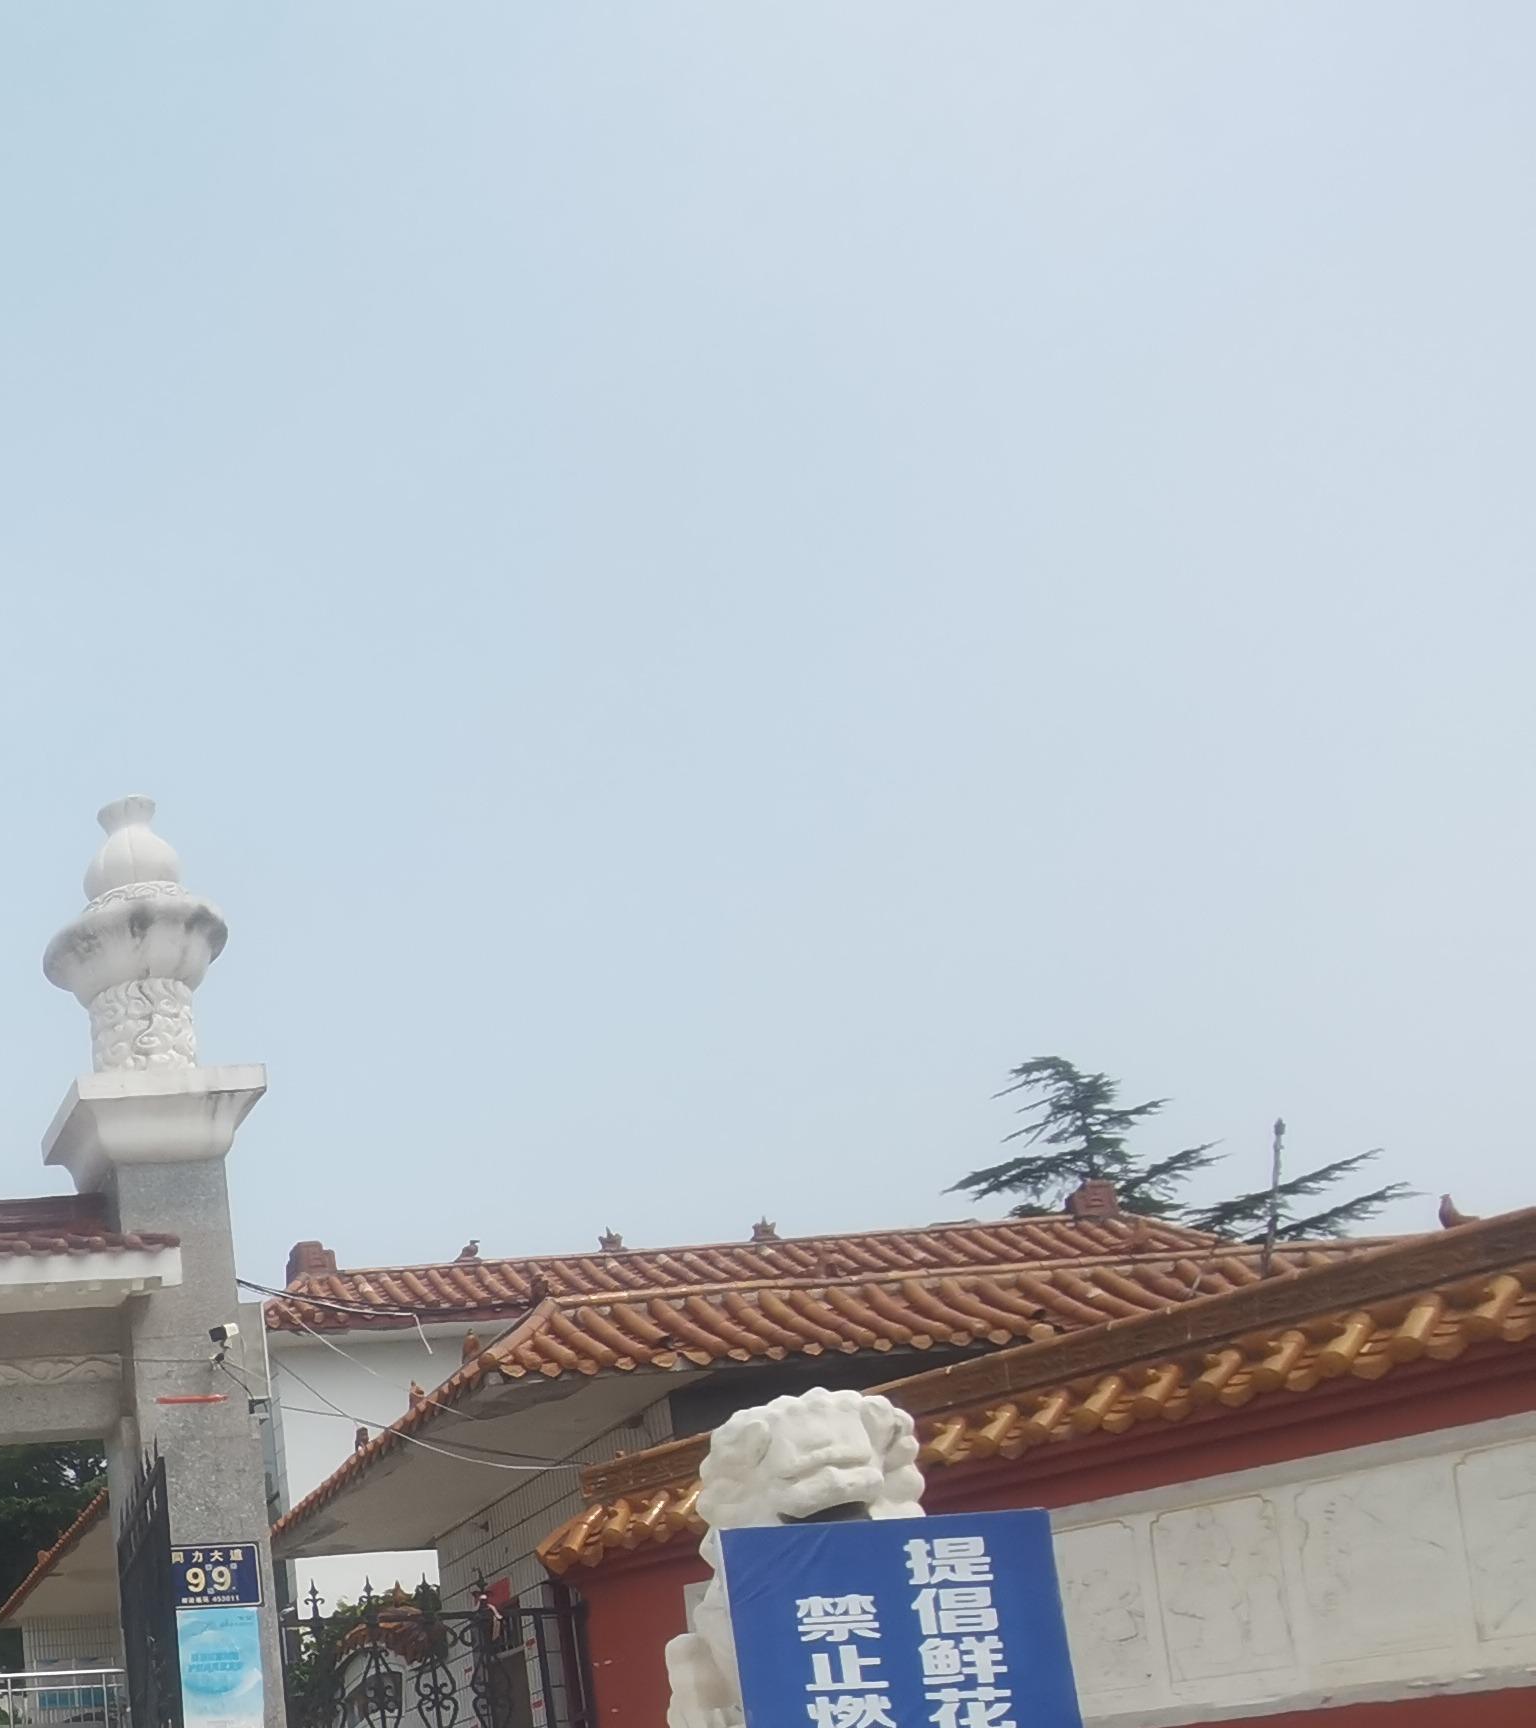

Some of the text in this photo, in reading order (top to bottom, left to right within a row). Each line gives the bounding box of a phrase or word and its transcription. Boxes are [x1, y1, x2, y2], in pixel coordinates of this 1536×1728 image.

[171, 1549, 243, 1564] 同力大道
[186, 1566, 231, 1592] 99
